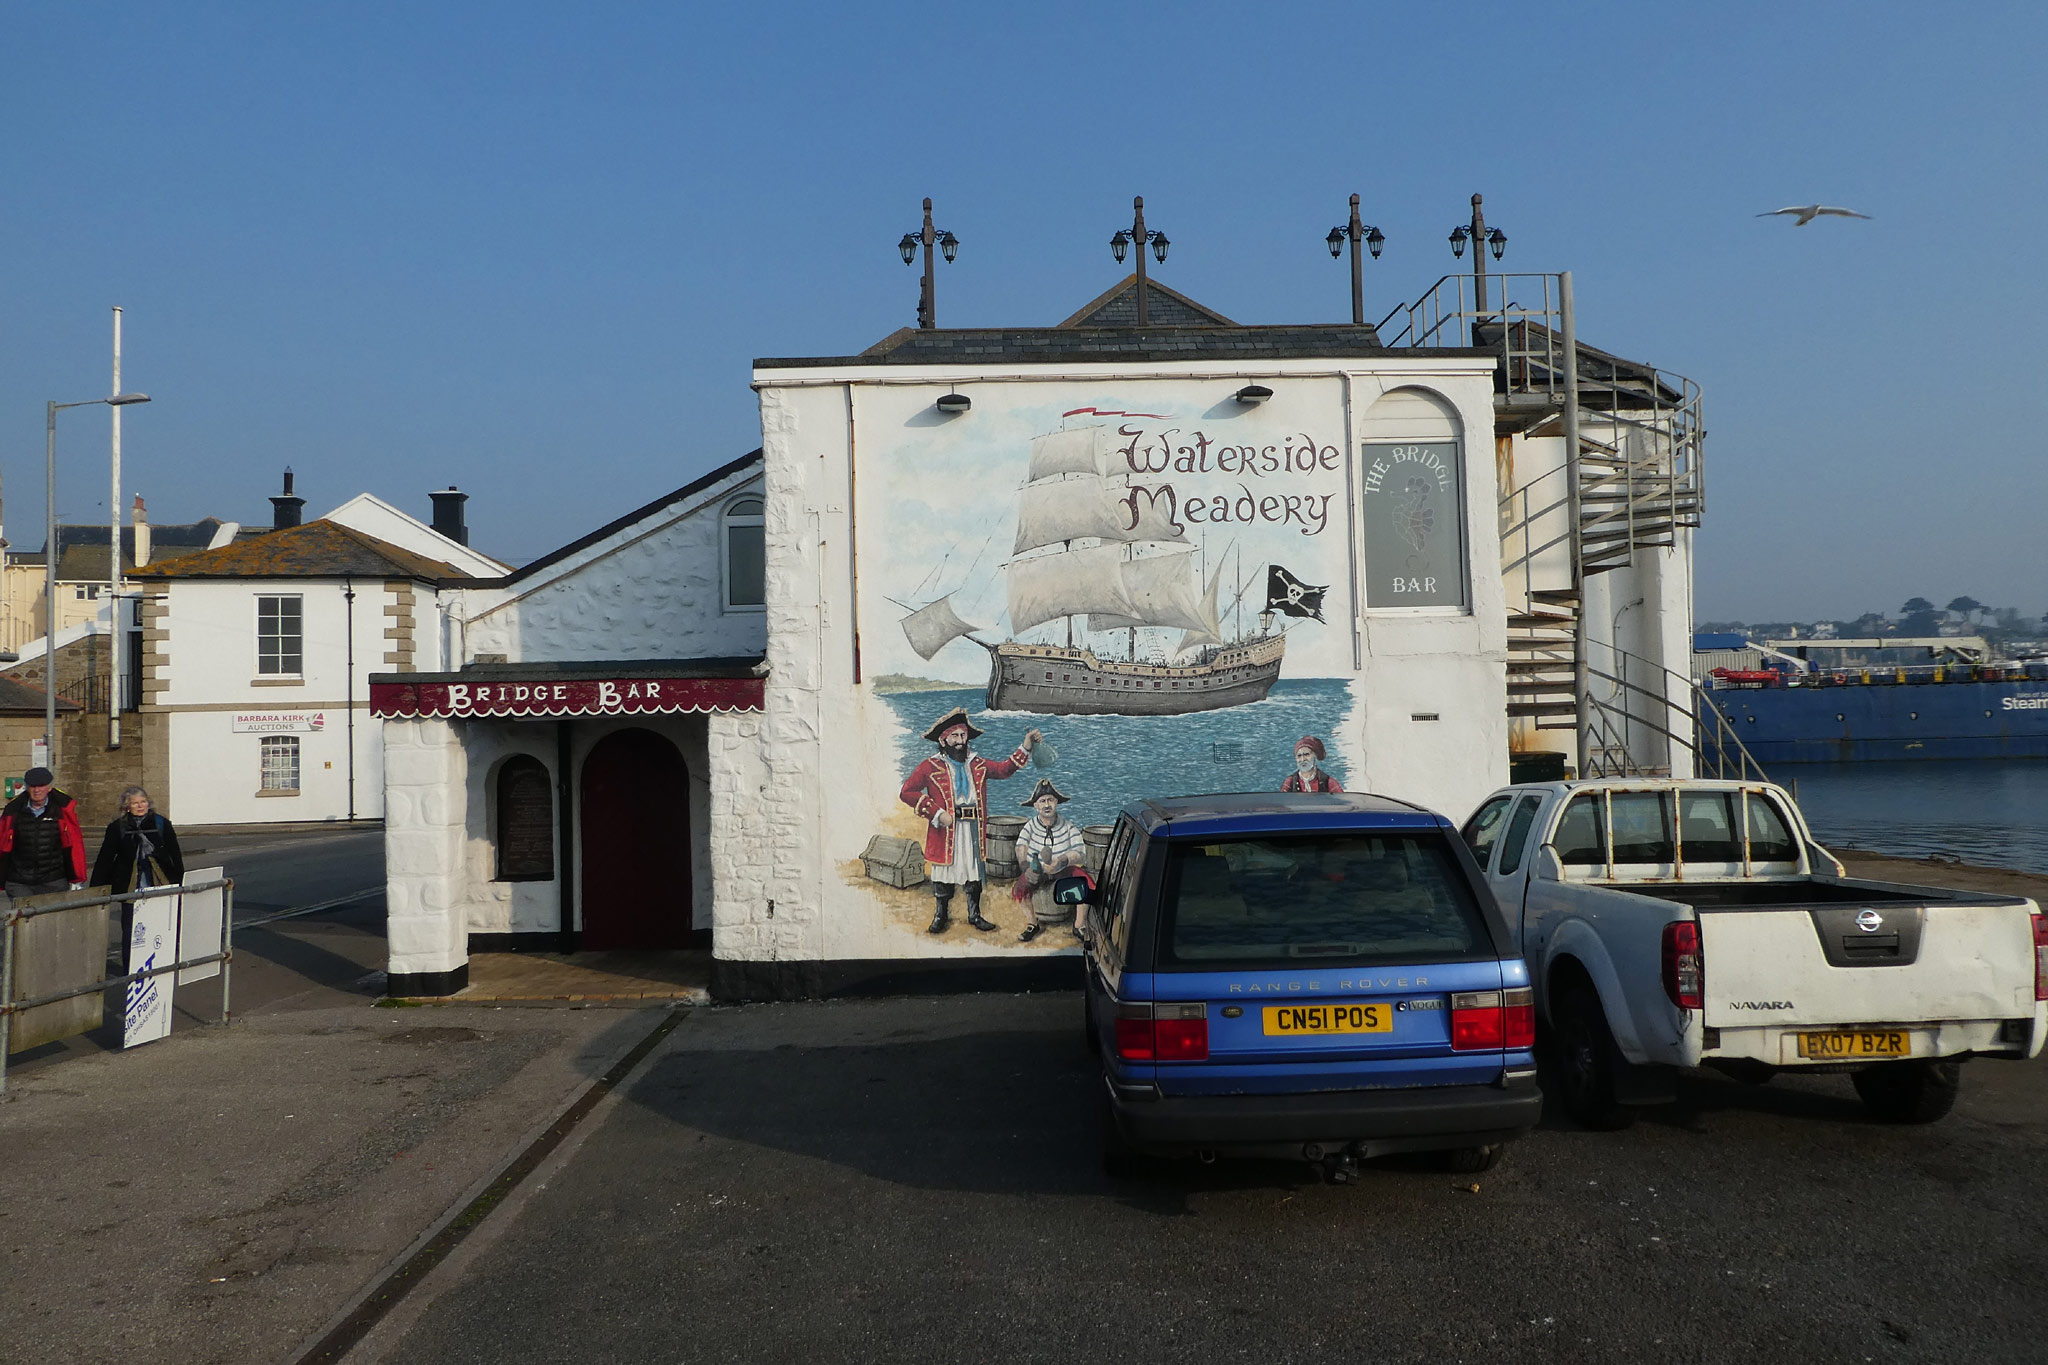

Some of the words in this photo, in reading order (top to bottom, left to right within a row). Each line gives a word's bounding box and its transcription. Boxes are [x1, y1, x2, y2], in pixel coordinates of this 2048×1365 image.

[1117, 423, 1340, 478] Waterside
[1364, 457, 1391, 495] THE
[1392, 446, 1453, 492] BRIDGE
[1118, 482, 1336, 537] Meadery
[1393, 576, 1437, 594] BAR
[599, 682, 661, 706] BAR
[247, 723, 294, 731] AUCTIONS
[1229, 981, 1321, 992] RANGE
[1340, 977, 1429, 988] ROVER
[137, 986, 159, 1018] Panel
[1729, 1000, 1794, 1011] NAVARA
[1277, 1008, 1328, 1030] CN51
[1334, 1007, 1378, 1028] POS
[1807, 1034, 1855, 1054] EX07
[1862, 1031, 1902, 1053] BZR
